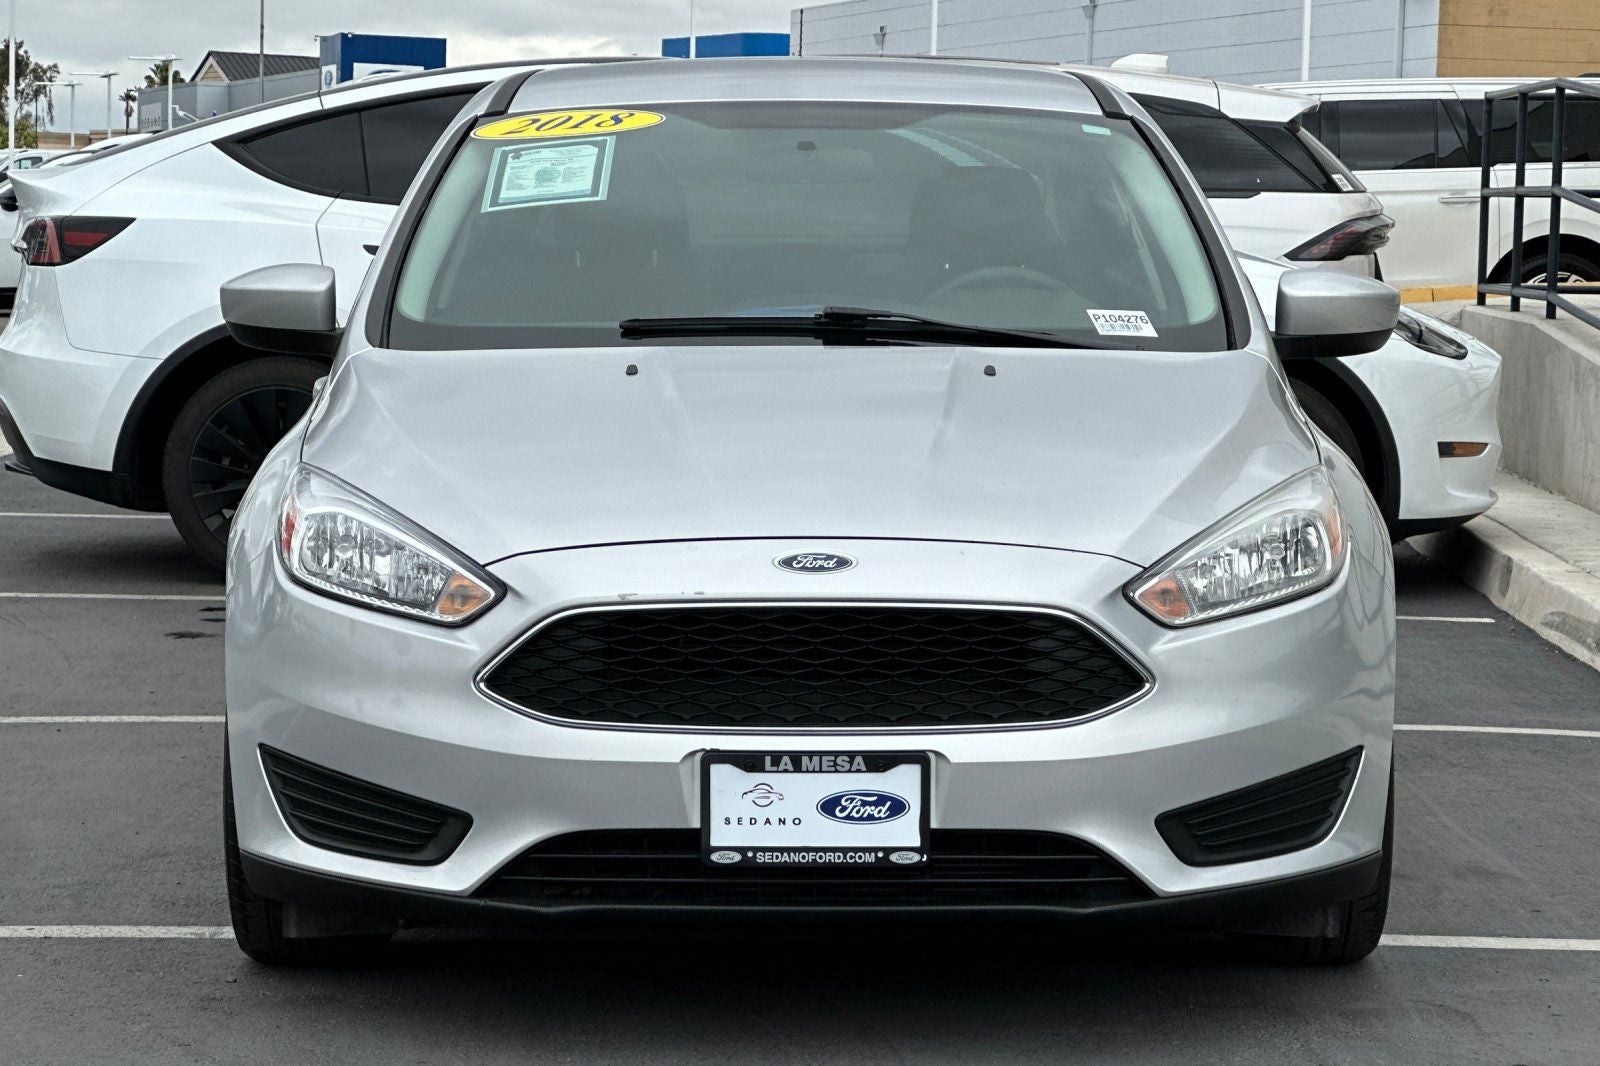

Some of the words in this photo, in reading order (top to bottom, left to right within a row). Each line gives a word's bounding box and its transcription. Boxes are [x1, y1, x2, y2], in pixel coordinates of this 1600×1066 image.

[500, 112, 635, 135] 2018
[1092, 313, 1149, 324] P104276
[792, 554, 838, 568] Ford
[764, 756, 794, 772] LA
[801, 756, 867, 772] MESA
[834, 794, 892, 819] Ford
[724, 817, 802, 826] SEDANO
[756, 851, 875, 863] SEDANOFORD.COM
